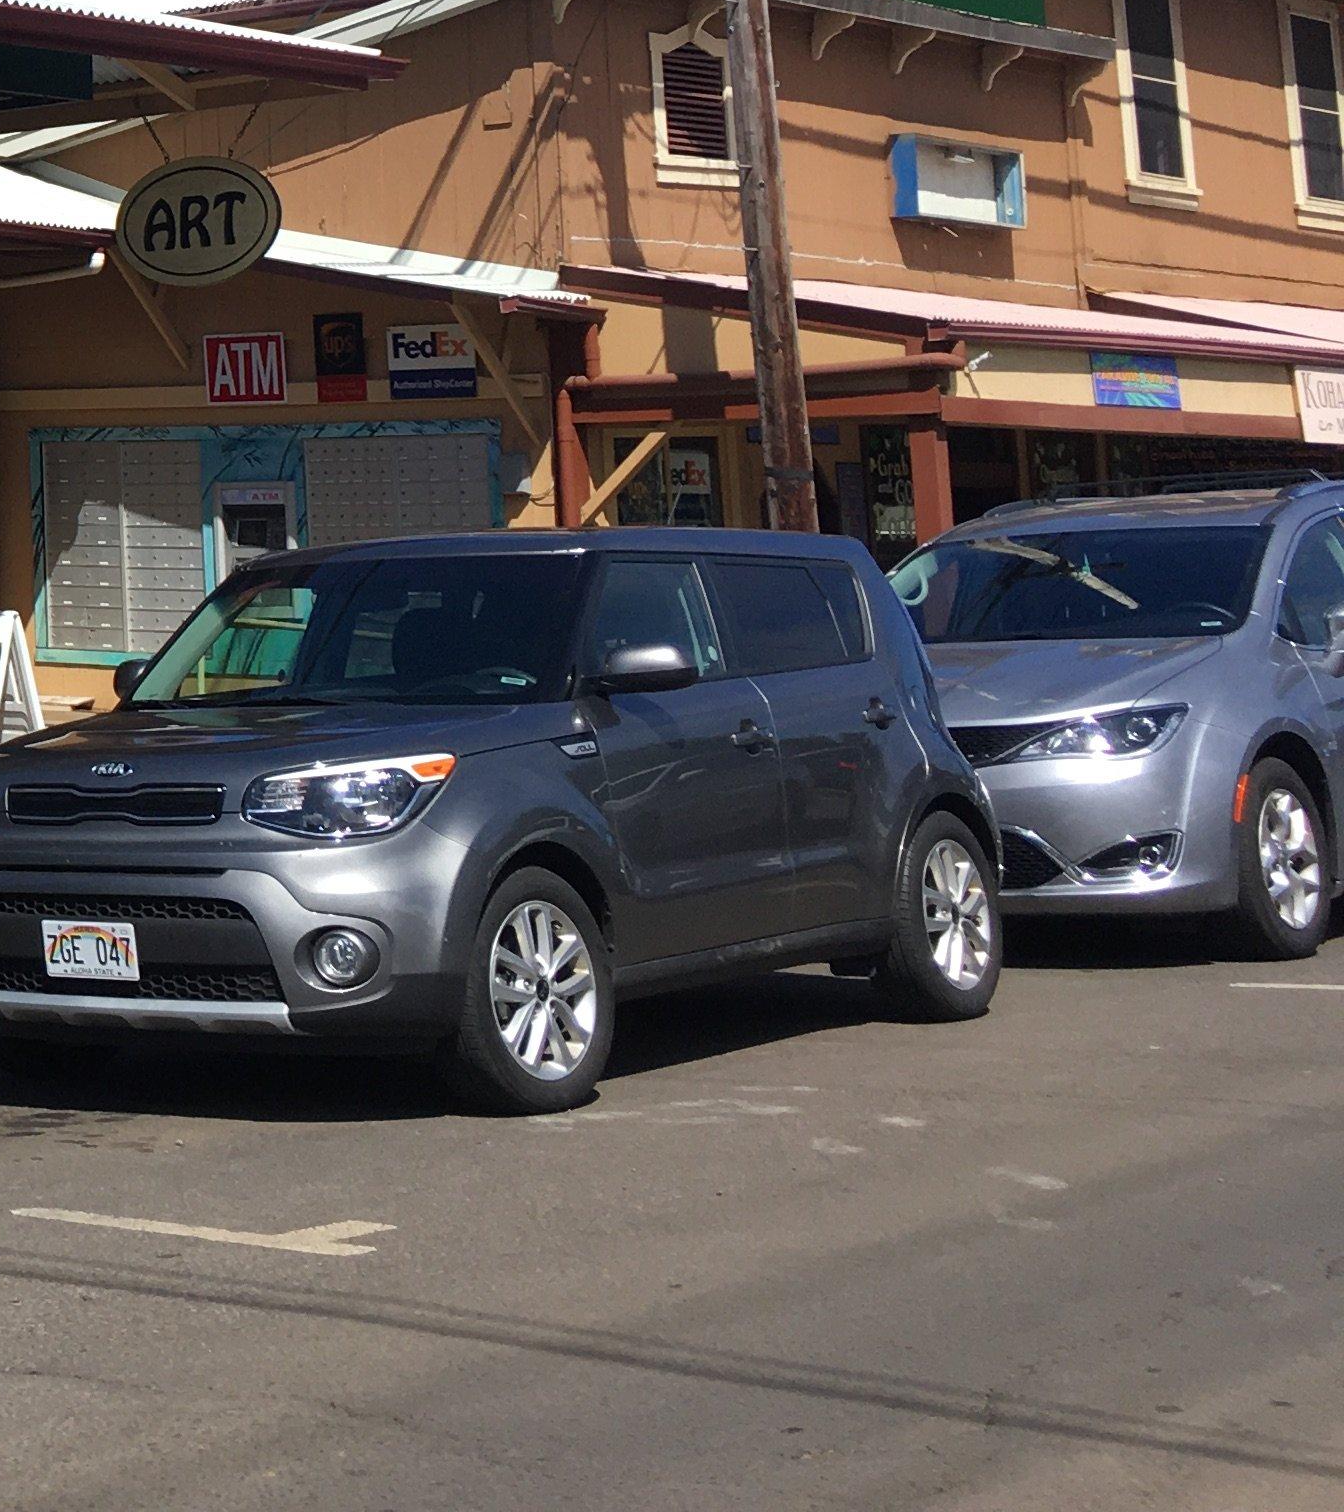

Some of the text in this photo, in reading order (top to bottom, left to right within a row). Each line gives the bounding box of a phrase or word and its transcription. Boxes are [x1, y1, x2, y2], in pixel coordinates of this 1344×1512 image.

[143, 191, 246, 252] ART
[323, 335, 355, 357] ups
[392, 331, 468, 359] FedEx
[213, 341, 280, 397] ATM
[671, 460, 706, 486] edEx
[251, 491, 280, 501] ATM
[97, 763, 125, 775] KIA
[47, 934, 131, 968] ZGE 047
[94, 968, 115, 976] STATE
